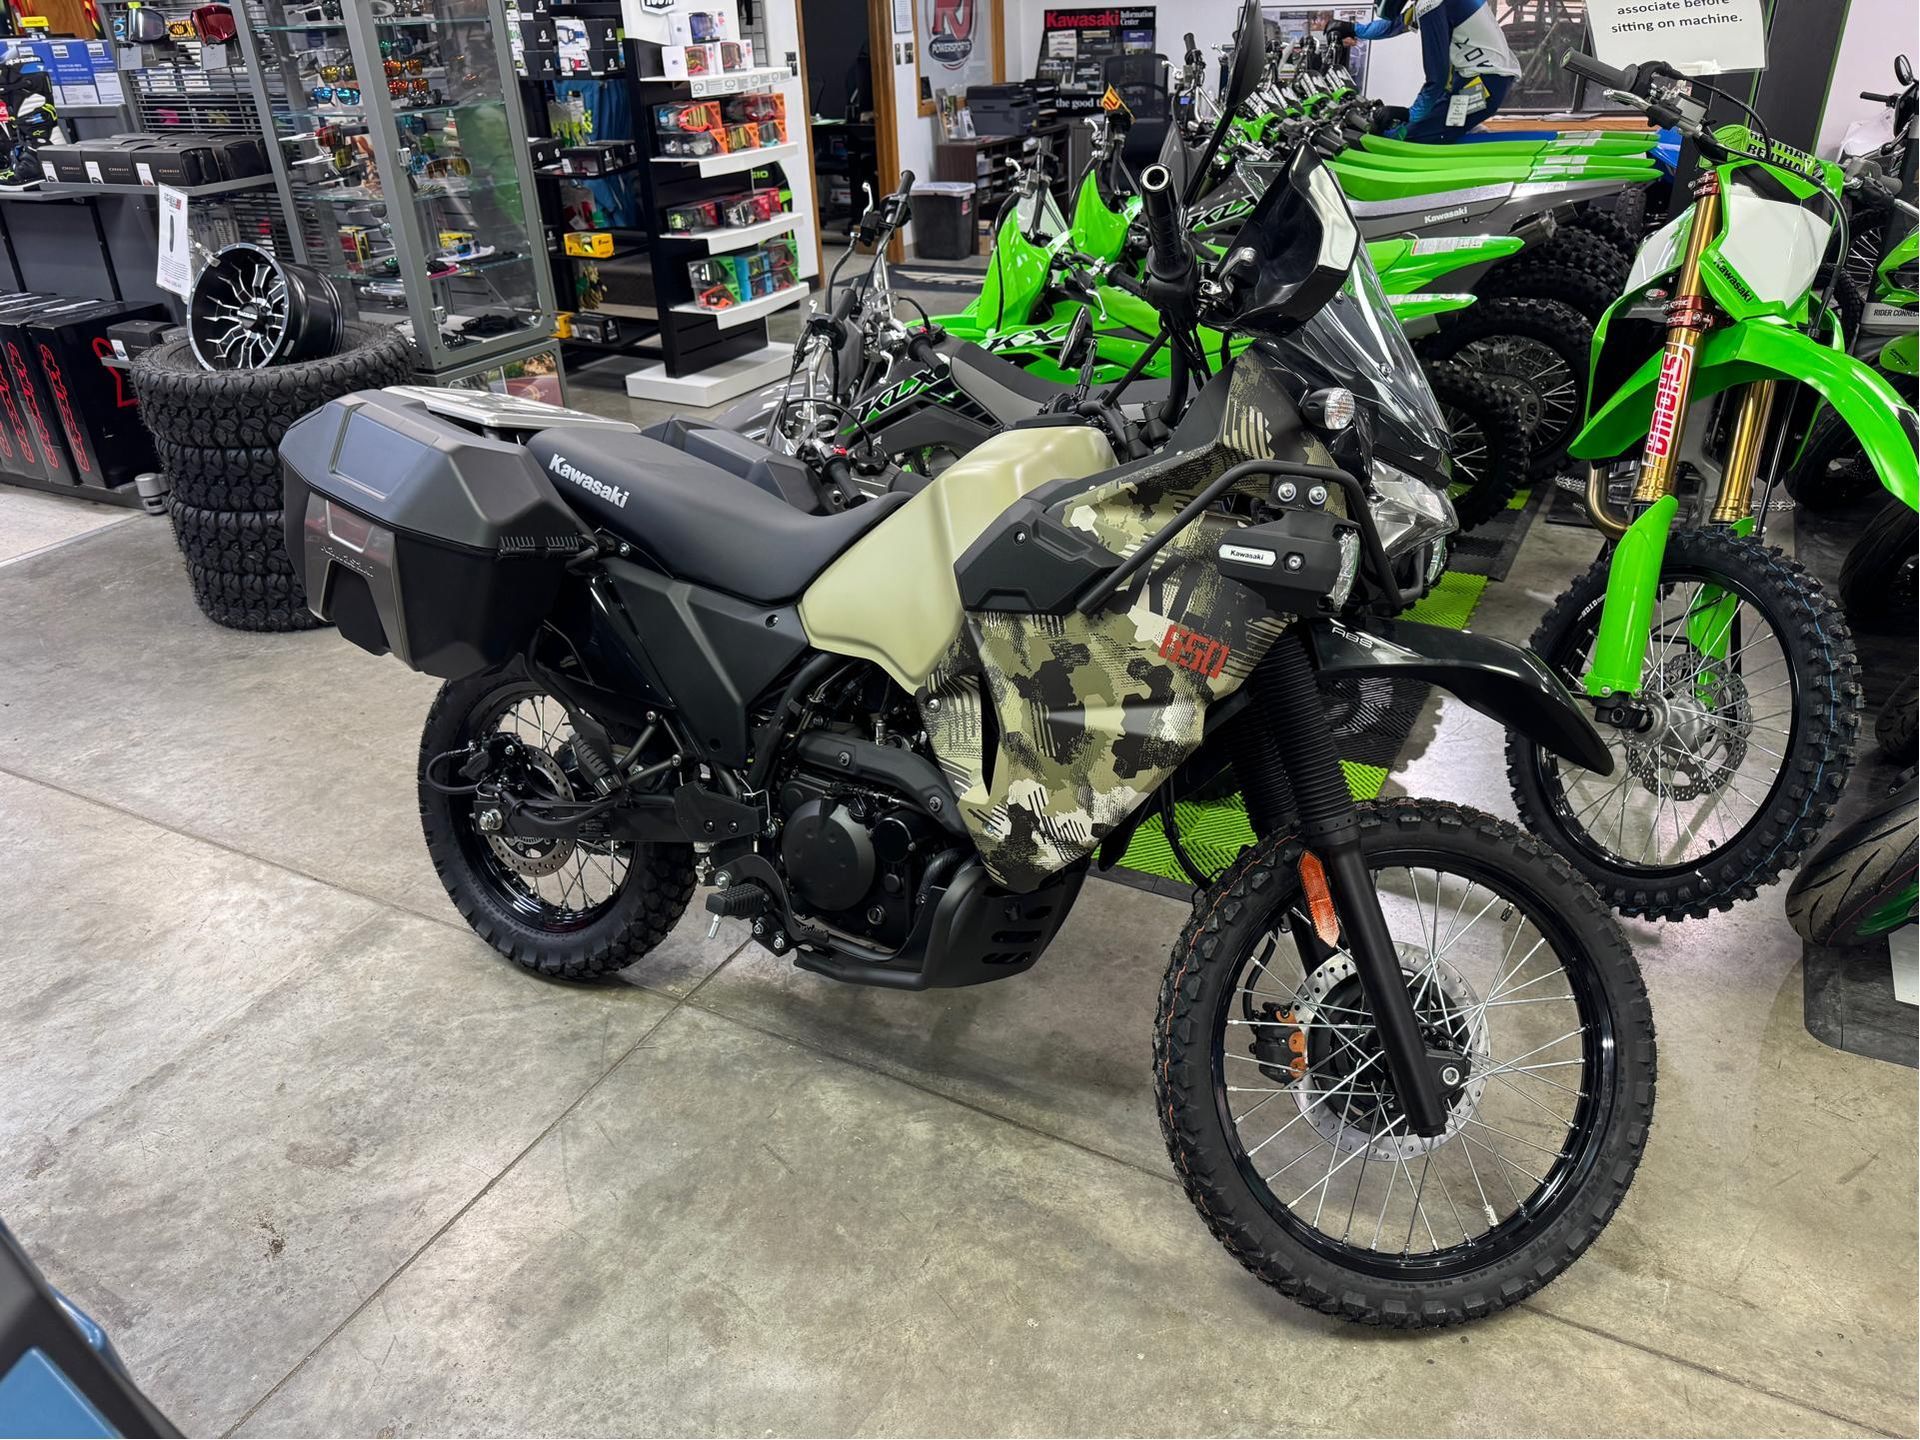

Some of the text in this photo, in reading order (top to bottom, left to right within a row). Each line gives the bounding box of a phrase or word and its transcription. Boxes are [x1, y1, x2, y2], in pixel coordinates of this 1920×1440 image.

[1120, 10, 1154, 18] Information
[1617, 0, 1680, 15] associate
[1046, 11, 1120, 28] Kawasaki
[1120, 18, 1140, 26] Center
[1611, 12, 1743, 33] sitting on machine.
[1056, 98, 1069, 107] the
[1072, 98, 1094, 109] good
[1424, 206, 1468, 224] Kawasaki
[1713, 257, 1754, 304] Kawasaki
[1873, 309, 1892, 317] RIDER
[853, 369, 942, 425] KLX
[548, 453, 630, 508] Kawasaki
[1230, 549, 1264, 560] Kawasaki
[1332, 626, 1374, 649] ABS
[1158, 623, 1232, 680] 650
